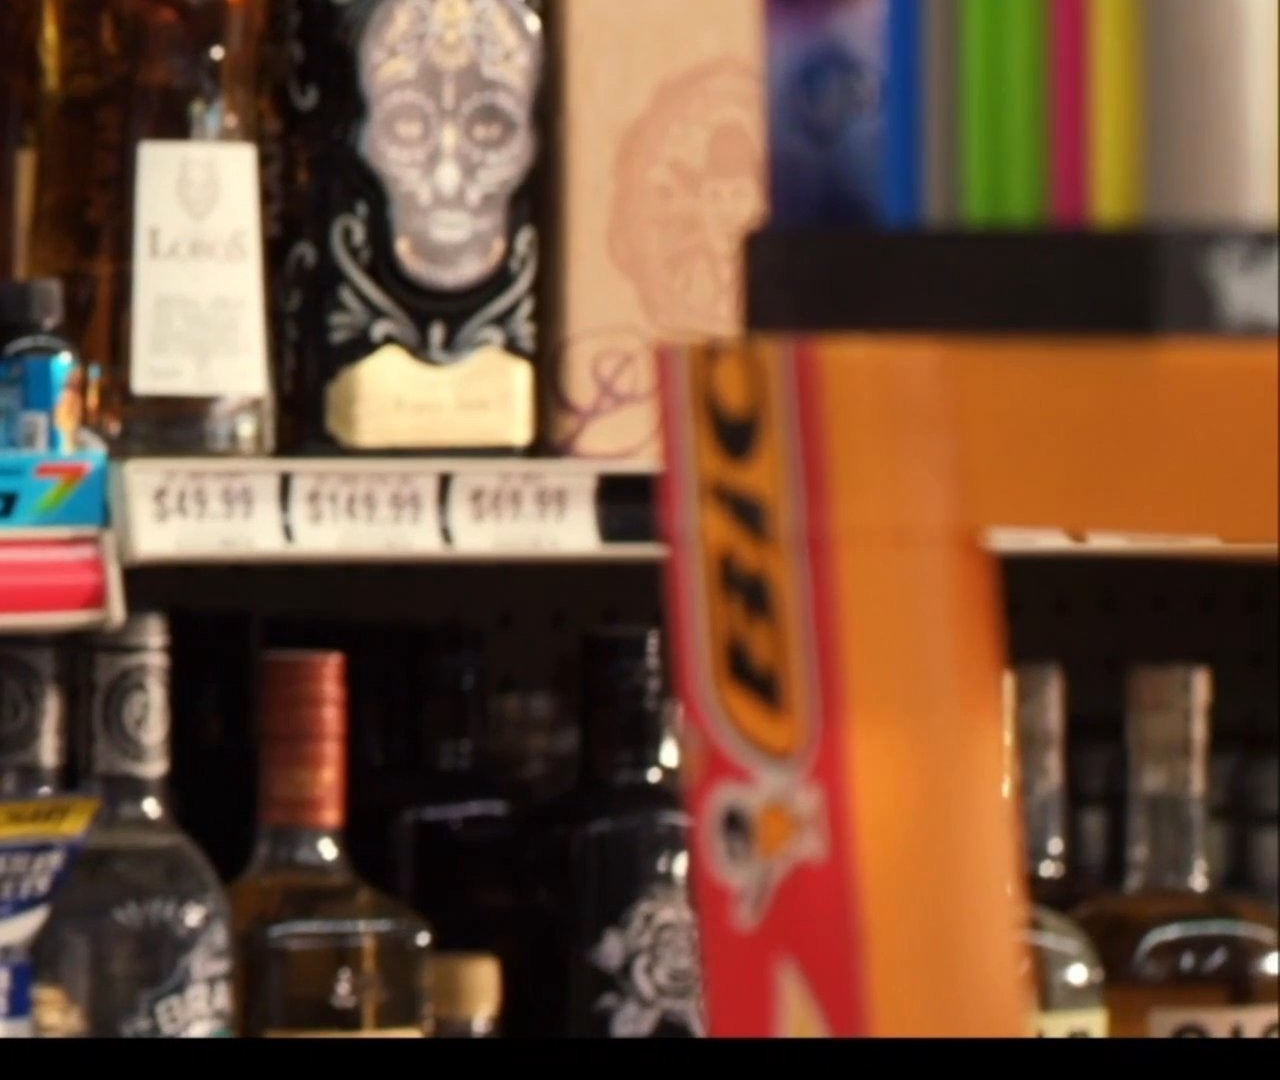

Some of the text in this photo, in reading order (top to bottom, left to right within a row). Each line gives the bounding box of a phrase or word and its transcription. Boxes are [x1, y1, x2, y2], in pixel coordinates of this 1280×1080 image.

[34, 461, 93, 517] 7
[151, 485, 255, 525] $49.99
[306, 487, 425, 528] $149.99
[469, 484, 570, 524] $69.99
